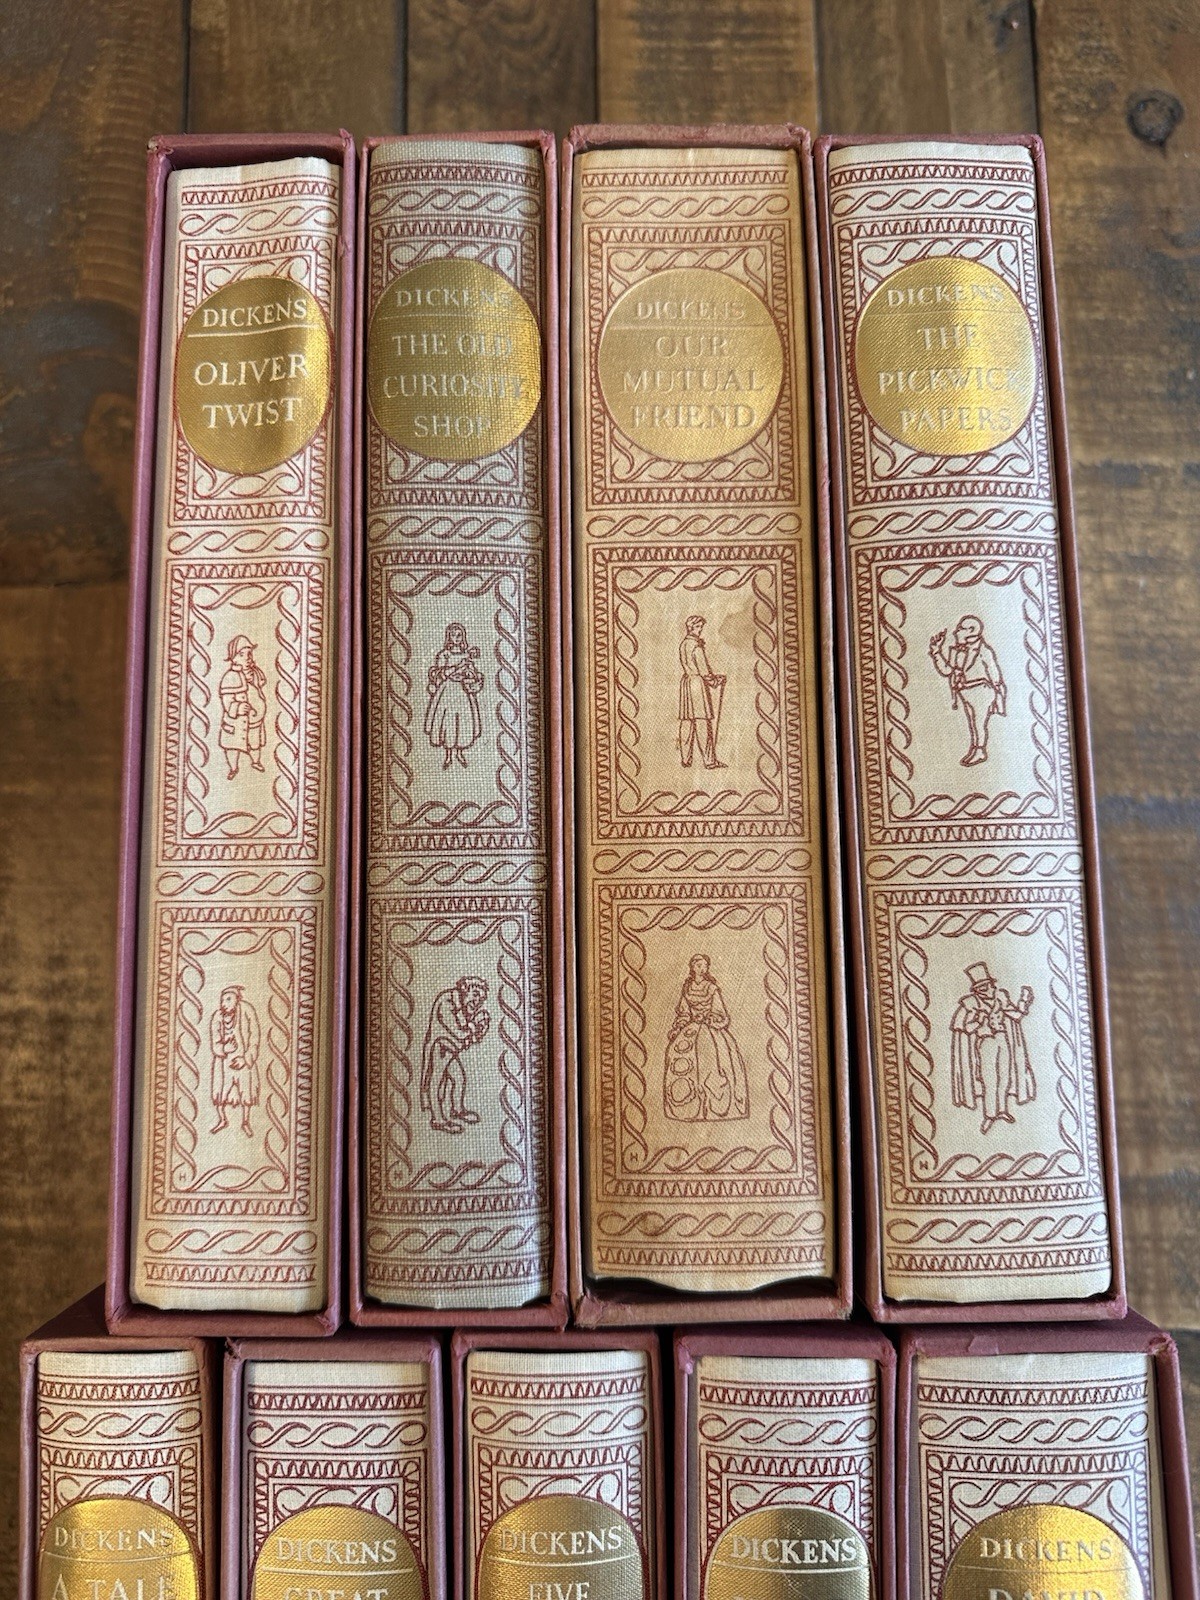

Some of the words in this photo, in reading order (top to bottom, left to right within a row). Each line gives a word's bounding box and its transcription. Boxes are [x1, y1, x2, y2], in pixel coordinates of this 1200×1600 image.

[395, 288, 512, 308] DICKENS
[887, 284, 1004, 307] DICKENS
[203, 298, 307, 328] DICKENS
[635, 300, 745, 321] DICKENS
[392, 334, 448, 356] THE
[457, 333, 513, 357] OLD
[655, 335, 730, 359] OUR
[917, 324, 979, 351] THE
[194, 353, 309, 386] OLIVER
[622, 369, 765, 393] MUTUAL
[877, 366, 1021, 396] PICKWICK
[383, 374, 524, 400] CURIOSITY
[203, 397, 301, 429] TWIST
[631, 404, 758, 429] FRIEND
[900, 407, 1012, 433] PAPERS
[413, 415, 491, 439] SHOP
[54, 1526, 175, 1551] DICKENS
[276, 1537, 398, 1564] DICKENS
[501, 1525, 624, 1555] DICKENS
[730, 1536, 858, 1564] DICKENS
[979, 1536, 1112, 1562] DICKENS
[52, 1573, 70, 1600] A
